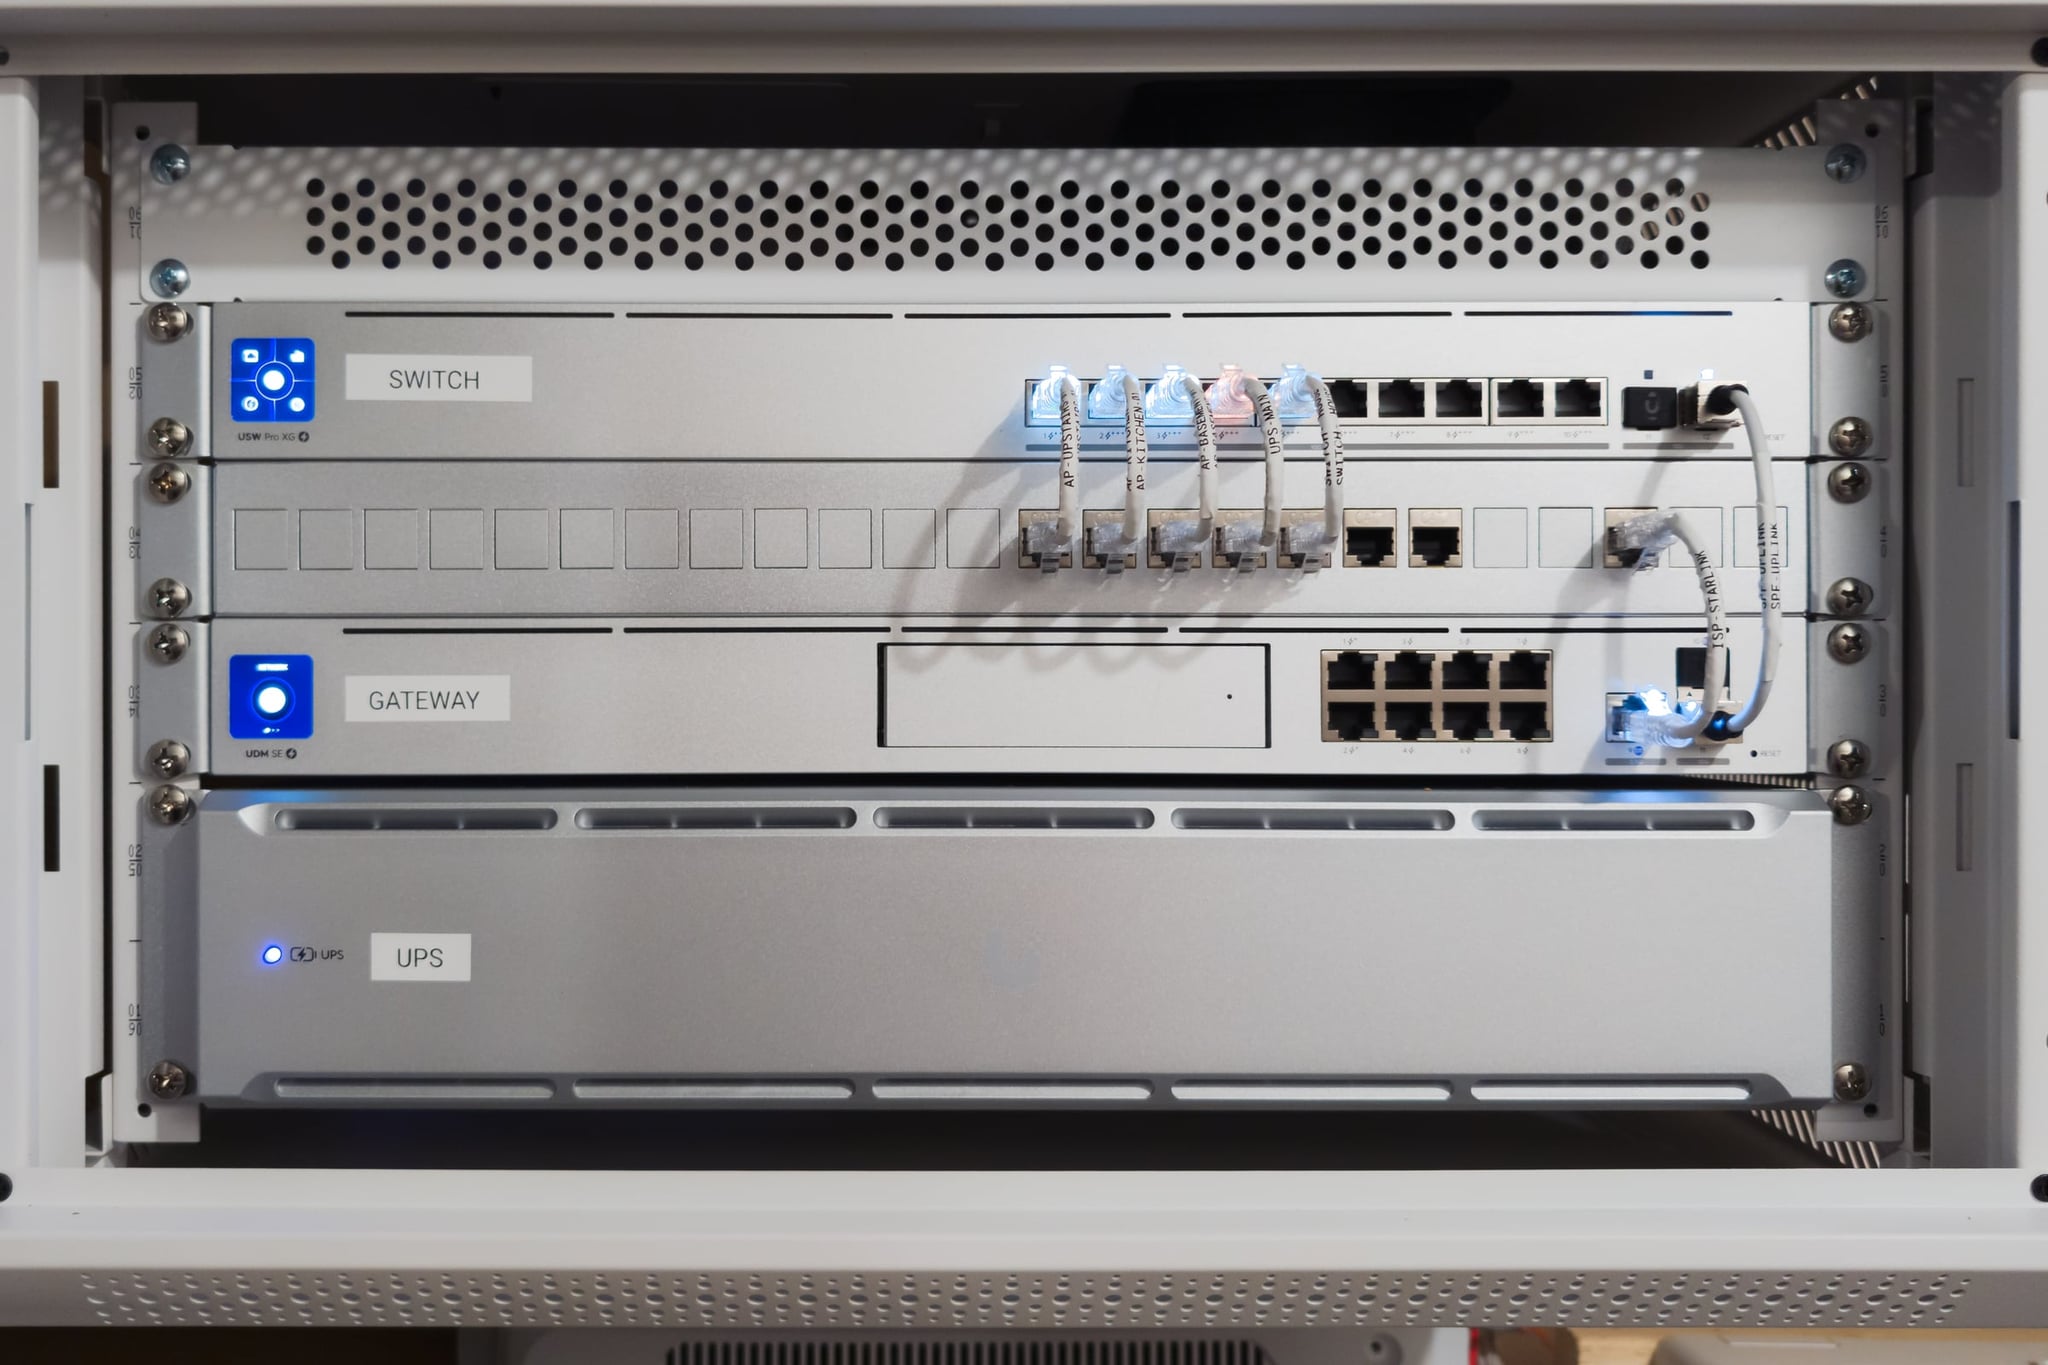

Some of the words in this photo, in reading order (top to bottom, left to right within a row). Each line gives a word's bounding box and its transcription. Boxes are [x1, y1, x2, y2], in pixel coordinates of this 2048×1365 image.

[389, 369, 480, 390] SWITCH
[1257, 393, 1281, 455] UPS-MAIN
[238, 432, 262, 441] USW
[264, 432, 280, 441] Pro
[281, 432, 296, 441] XG
[1694, 550, 1724, 648] ISP-STARLINK
[369, 690, 480, 711] GATEWAY
[245, 749, 269, 758] UDM
[271, 749, 283, 758] SE
[321, 949, 345, 961] UPS
[397, 947, 444, 969] UPS
